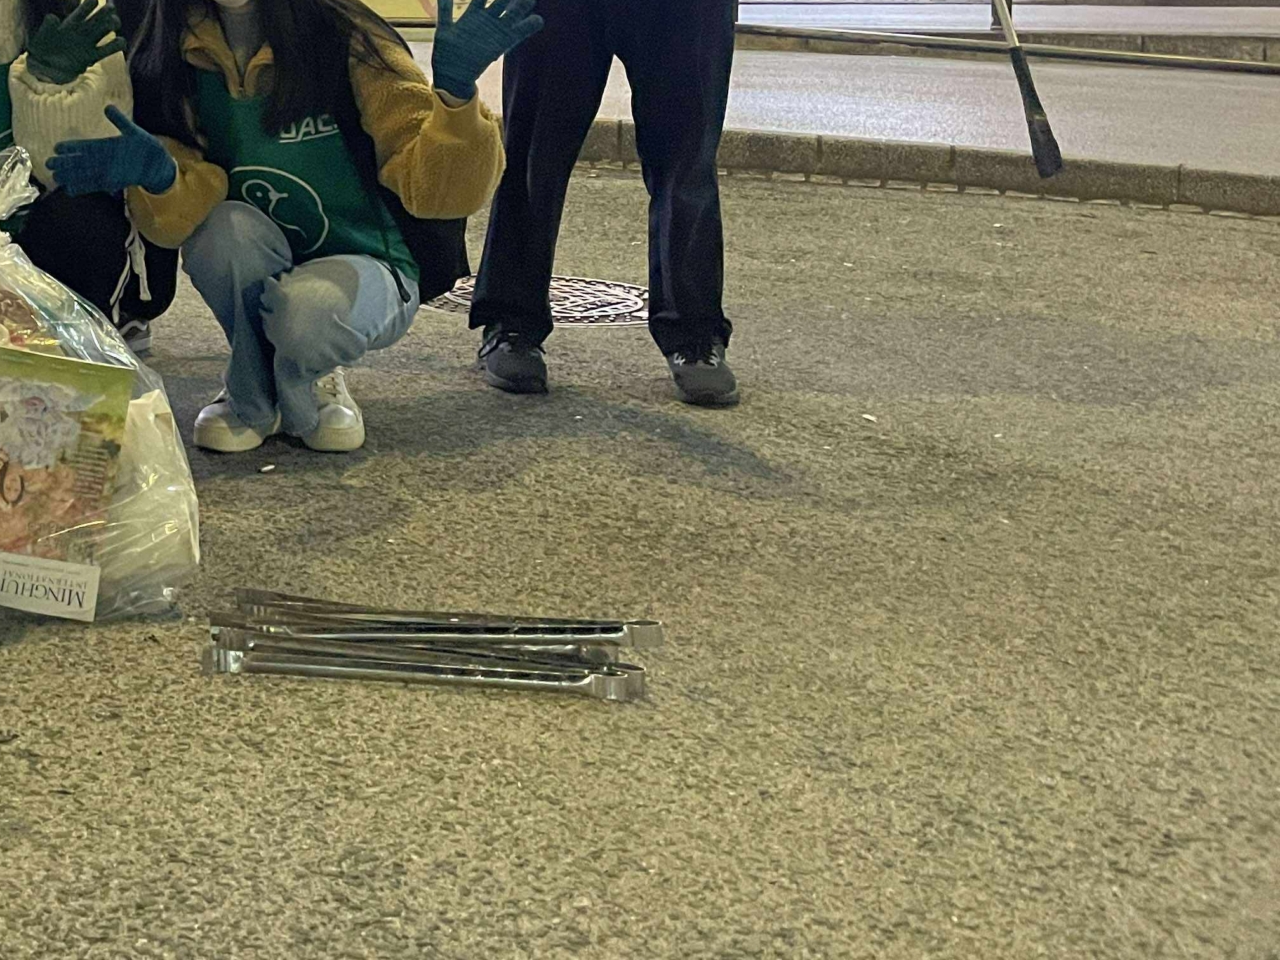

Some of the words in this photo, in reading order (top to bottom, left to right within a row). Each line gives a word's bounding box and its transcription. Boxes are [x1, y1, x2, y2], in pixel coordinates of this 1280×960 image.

[279, 113, 340, 144] UAC
[0, 577, 86, 609] MINGHUI
[2, 569, 88, 590] INTERNATIONAL
